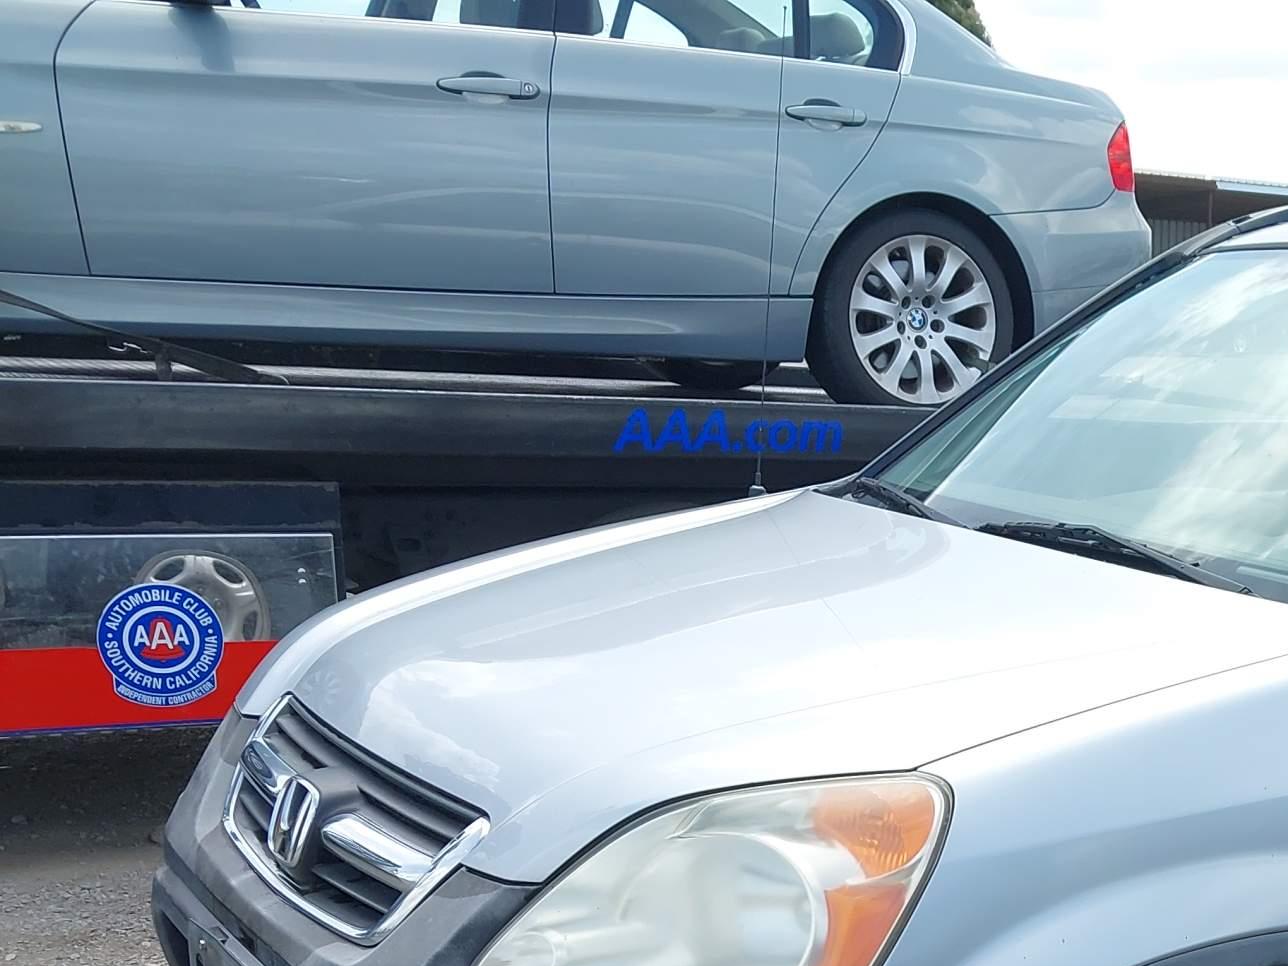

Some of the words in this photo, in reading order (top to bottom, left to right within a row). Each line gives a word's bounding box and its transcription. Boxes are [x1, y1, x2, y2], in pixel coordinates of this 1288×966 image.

[613, 407, 844, 453] AAA.com
[105, 589, 182, 631] AUTOMOBILE
[182, 597, 214, 626] CLUB
[133, 622, 190, 650] AAA
[104, 640, 162, 690] SOUTHERN
[166, 635, 218, 690] CALIFORNIA
[117, 684, 166, 705] INDEPENDENT
[168, 681, 214, 705] CONTRACTOR
